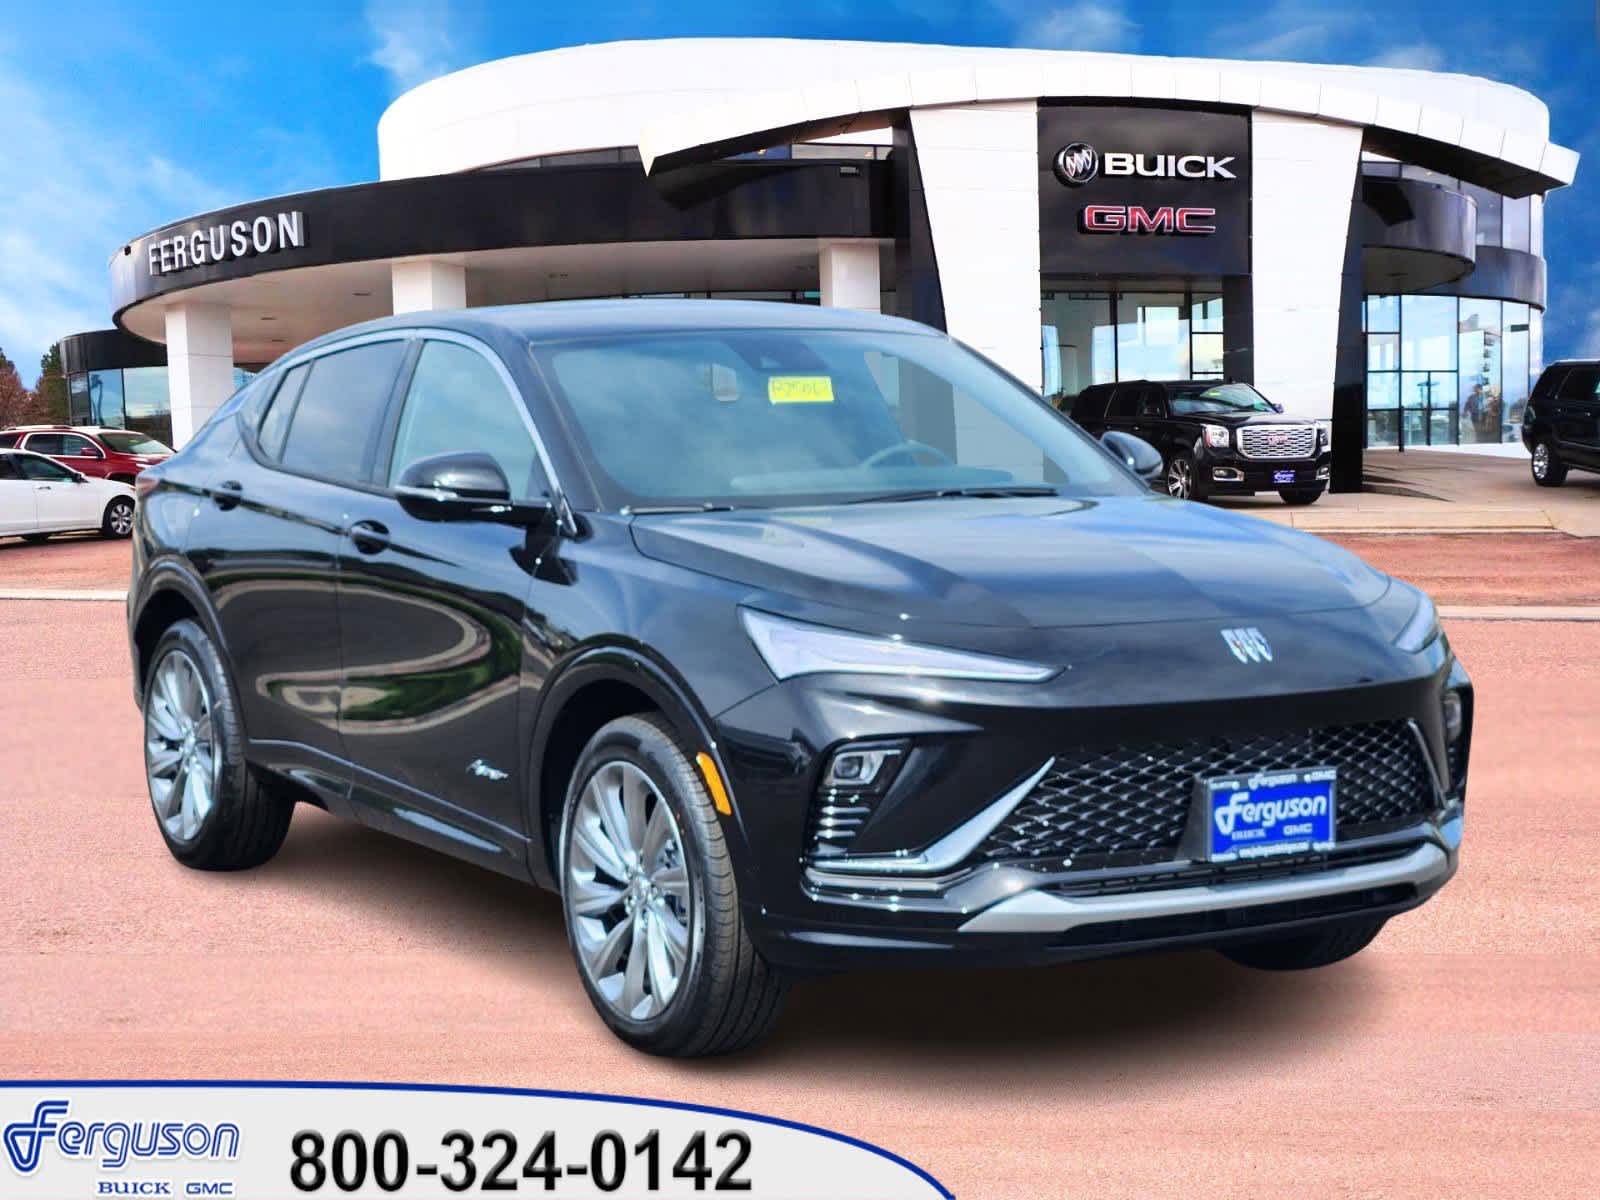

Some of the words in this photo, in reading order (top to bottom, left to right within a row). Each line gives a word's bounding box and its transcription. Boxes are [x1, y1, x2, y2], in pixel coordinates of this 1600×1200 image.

[1104, 152, 1237, 179] BUICK
[1083, 205, 1216, 233] GMC
[148, 210, 304, 276] FERGUSON
[1214, 791, 1327, 836] Ferguson
